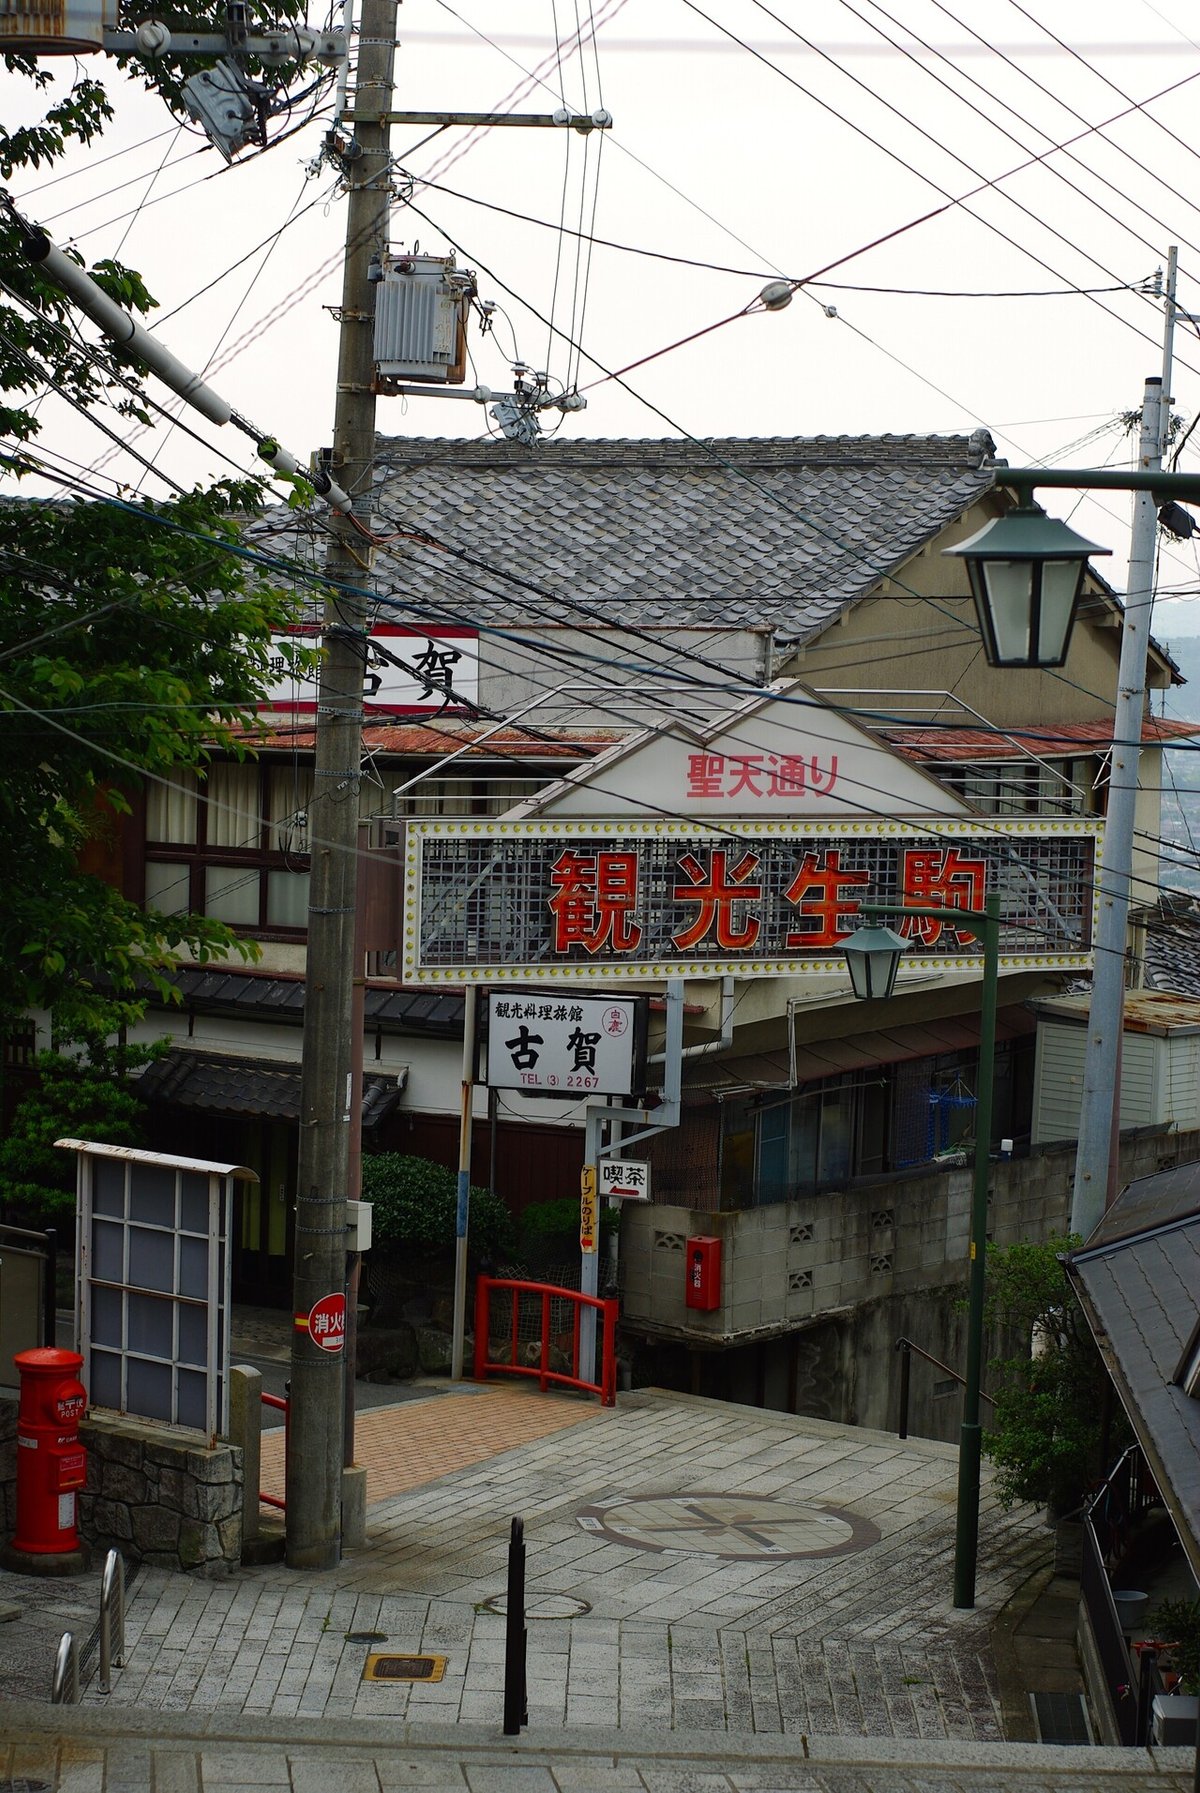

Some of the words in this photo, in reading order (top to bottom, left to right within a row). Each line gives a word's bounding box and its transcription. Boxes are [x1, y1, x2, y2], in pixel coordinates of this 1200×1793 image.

[686, 754, 838, 798] 聖天通り
[546, 846, 988, 955] 観光生駒
[495, 1001, 584, 1022] 観光料理旅館
[504, 1024, 603, 1076] 古賀
[520, 1073, 542, 1085] TEL
[547, 1074, 560, 1087] (3)
[566, 1075, 599, 1089] 2267
[603, 1165, 645, 1186] 喫茶
[582, 1166, 593, 1235] ケーブルのりば
[61, 1408, 79, 1419] POST
